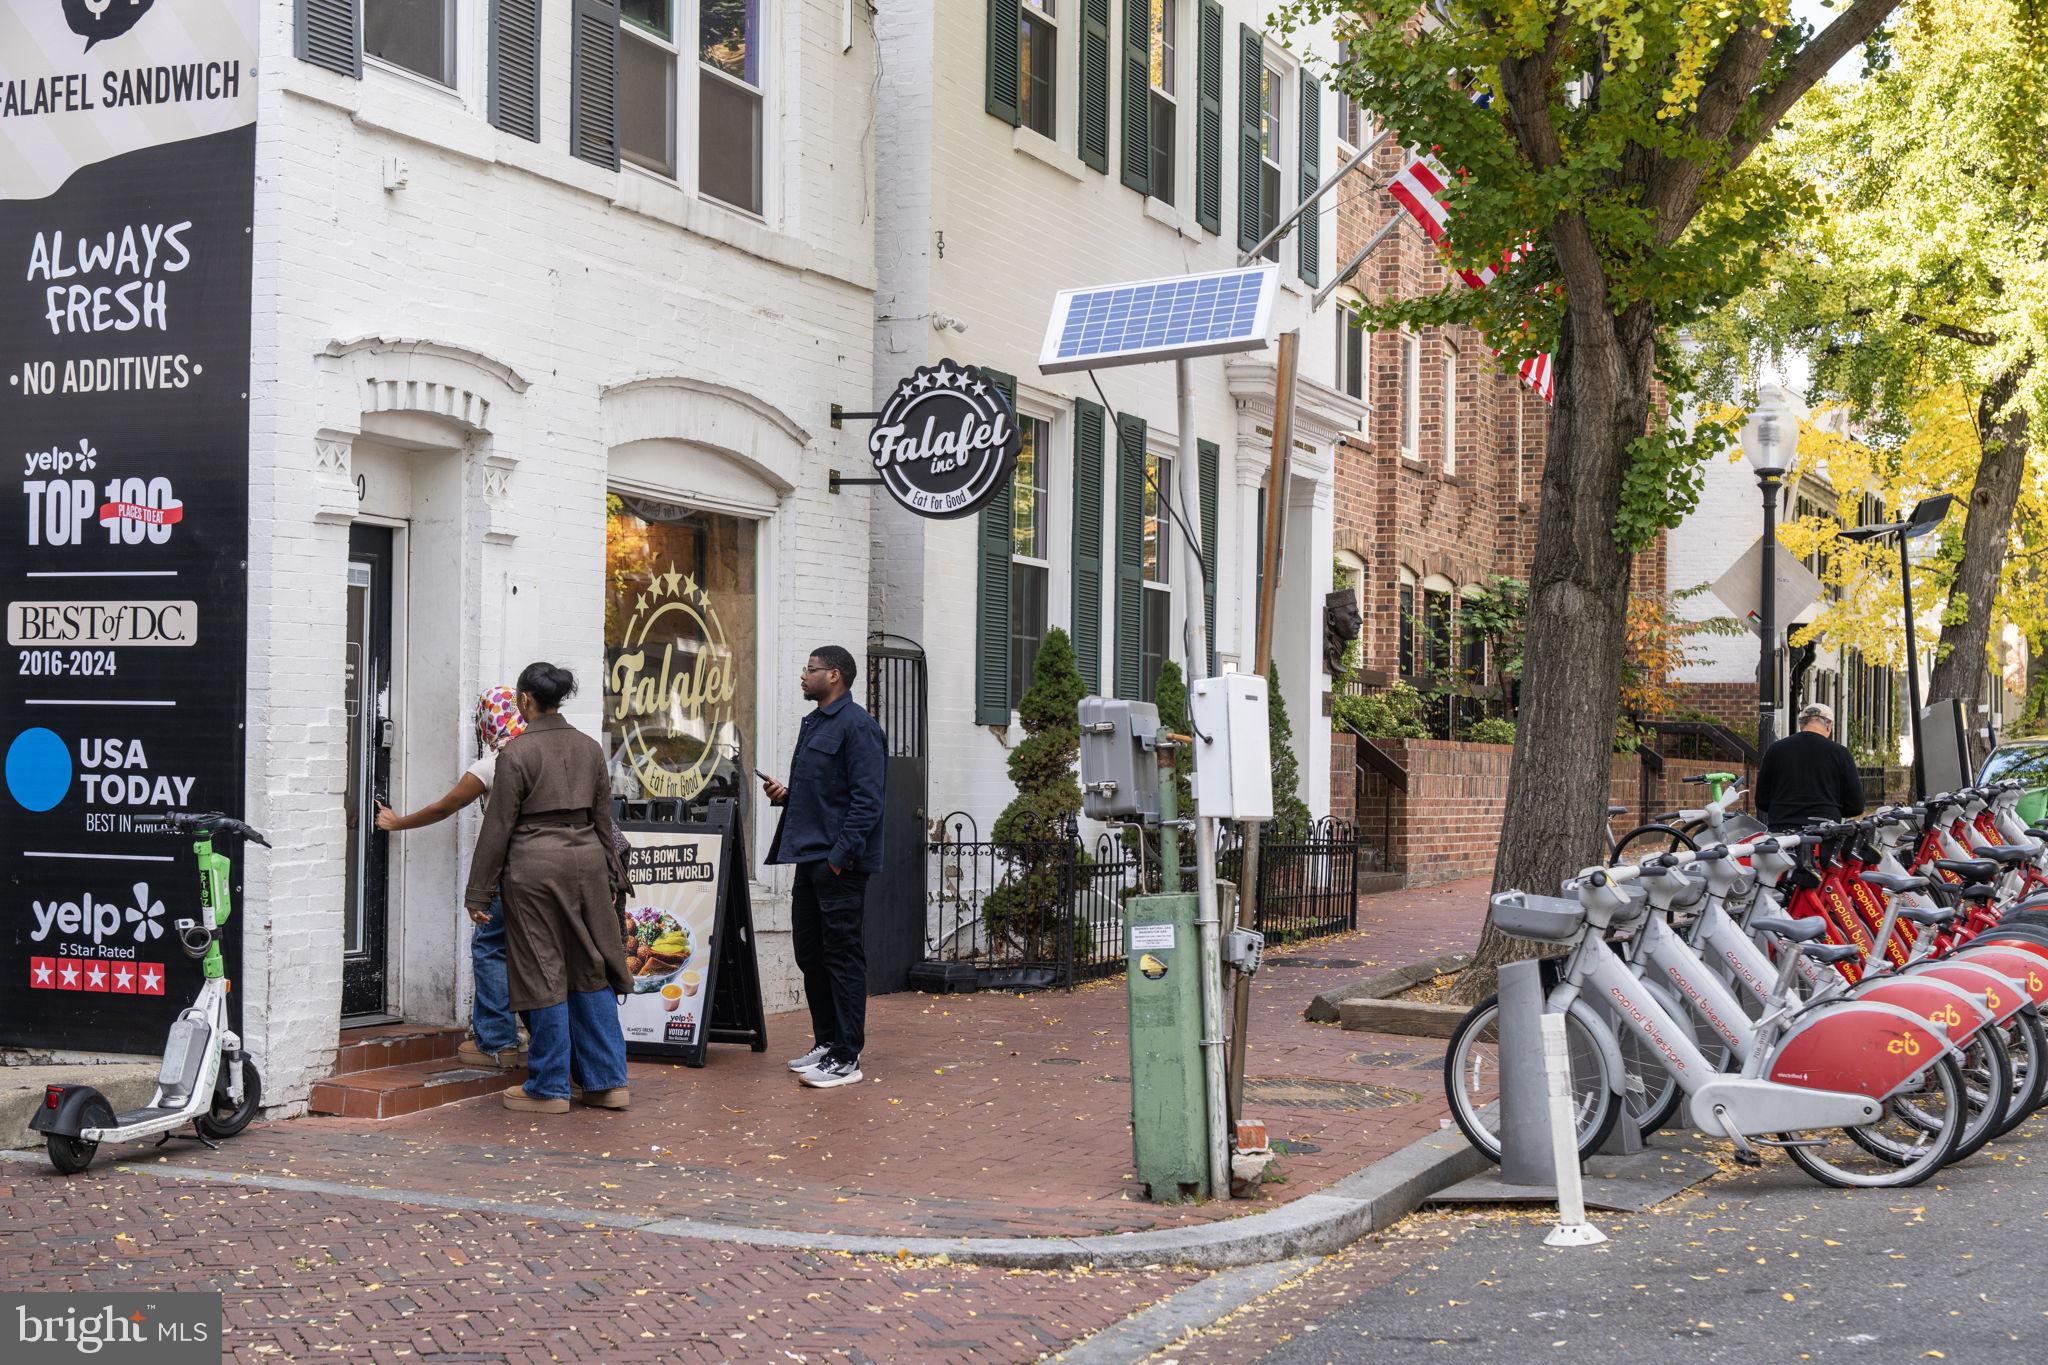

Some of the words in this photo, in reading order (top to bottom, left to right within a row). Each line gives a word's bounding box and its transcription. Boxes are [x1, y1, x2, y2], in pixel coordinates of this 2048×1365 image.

[0, 73, 94, 117] ALAFEL
[102, 60, 239, 108] SANDWICH
[27, 220, 192, 282] ALWAYS
[46, 279, 166, 335] FRESH
[23, 360, 55, 395] NO
[62, 354, 190, 393] ADDITIVES
[870, 412, 1011, 467] Falafel
[24, 446, 74, 476] yelp
[930, 457, 956, 474] inc
[23, 479, 96, 546] TOP
[101, 476, 176, 545] 100
[118, 504, 143, 520] PLACES
[143, 508, 152, 522] TO
[152, 510, 164, 523] EAT
[912, 491, 927, 508] Eat
[930, 497, 943, 510] for
[946, 492, 967, 508] Good
[19, 606, 105, 641] BEST
[102, 605, 128, 642] of
[129, 605, 186, 641] D.C.
[19, 650, 117, 676] 2016-2024
[611, 643, 737, 720] Falafel
[80, 738, 149, 769] USA
[80, 773, 196, 806] TODAY
[650, 767, 665, 794] Eat
[667, 776, 678, 797] for
[680, 769, 699, 797] Good
[86, 813, 116, 832] BEST
[119, 814, 132, 833] IN
[640, 850, 651, 865] $6
[653, 848, 681, 864] BOWL
[683, 847, 694, 862] IS
[654, 866, 674, 881] THE
[676, 864, 711, 881] WORLD
[1830, 893, 1857, 930] capital
[1853, 883, 1880, 918] capital
[31, 892, 121, 945] yelp
[59, 943, 68, 956] 5
[70, 944, 95, 957] Star
[98, 946, 135, 959] Rated
[1726, 950, 1756, 982] capital
[671, 1014, 686, 1022] yelp
[1668, 967, 1701, 1001] capital
[1699, 997, 1740, 1046] bikeshare
[669, 1028, 683, 1036] VOTED
[1611, 987, 1646, 1023] capital
[1643, 1019, 1686, 1071] bikeshare
